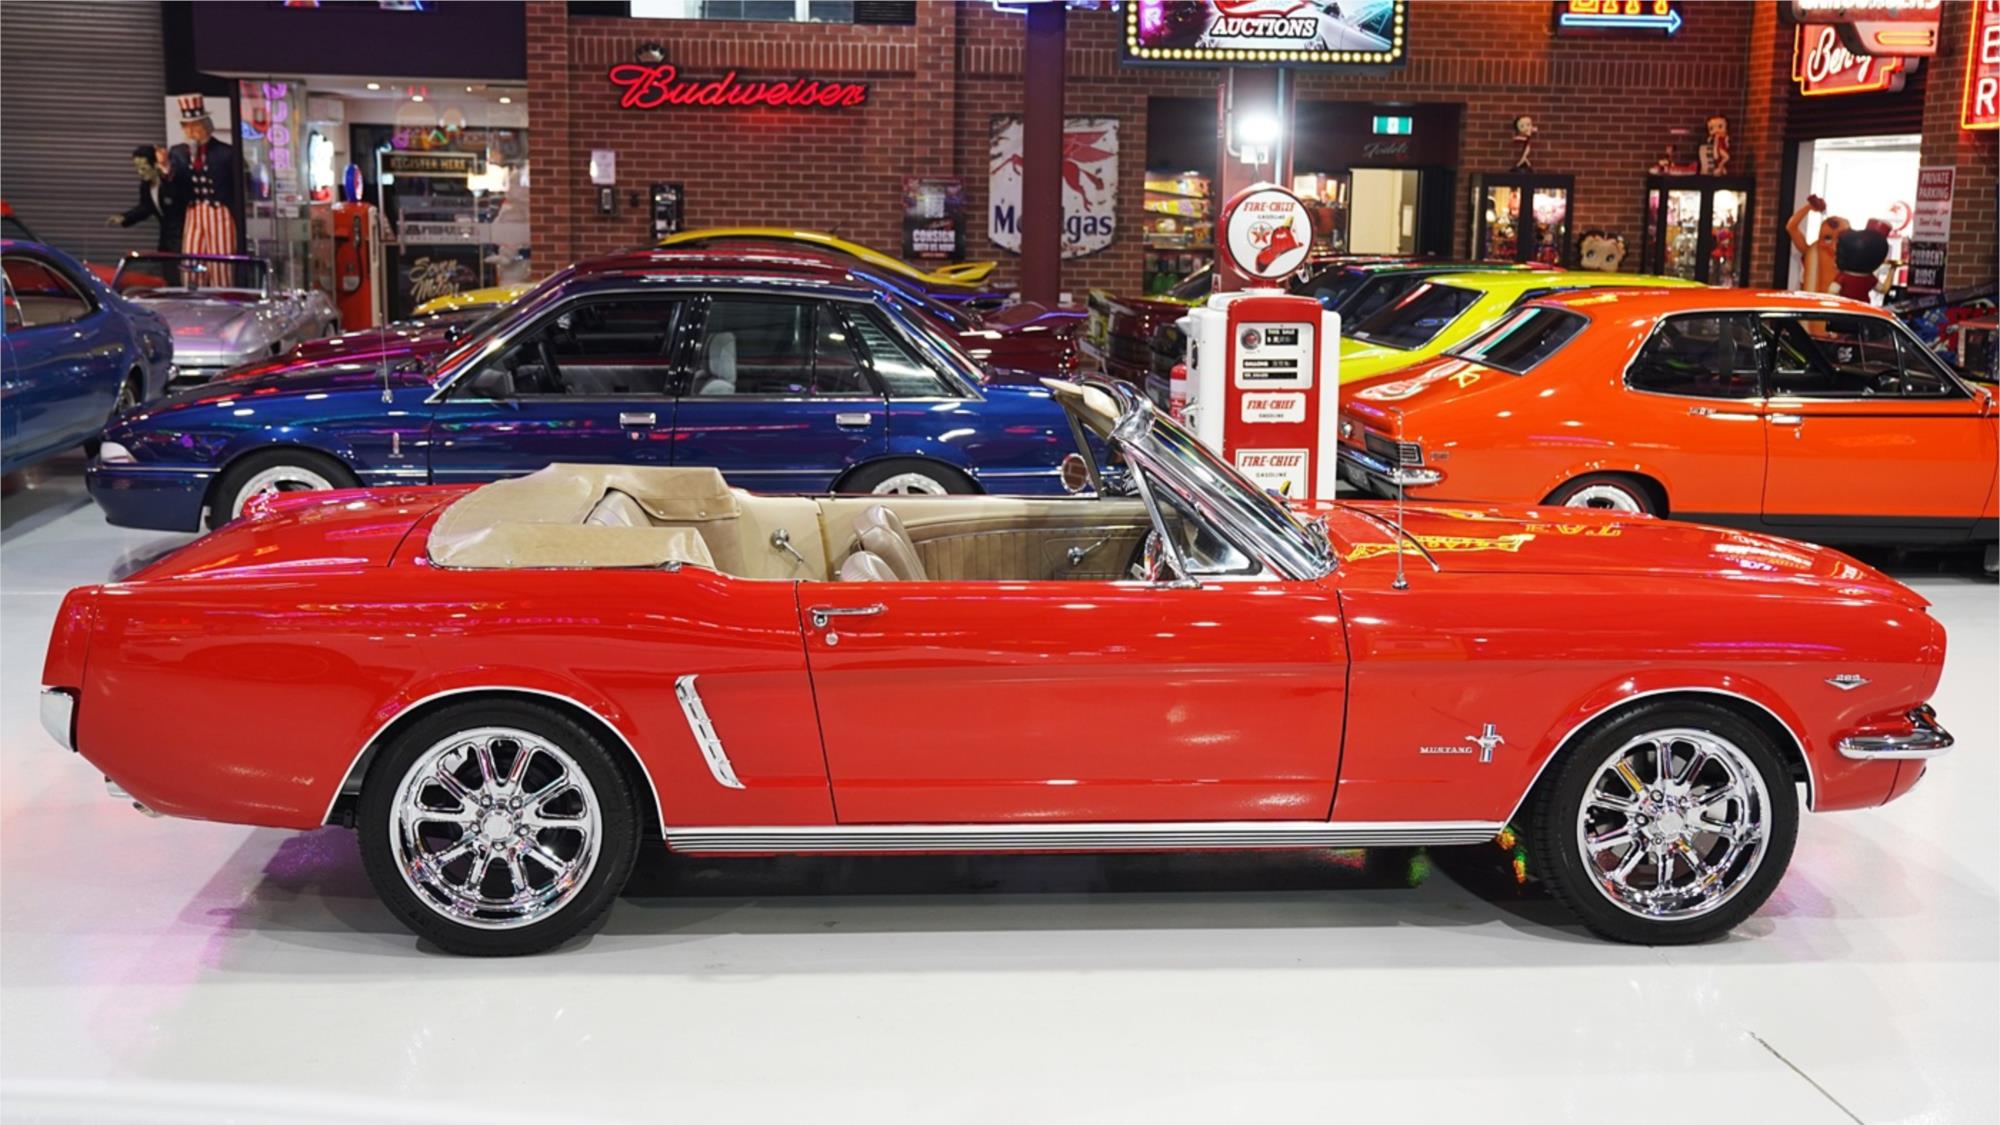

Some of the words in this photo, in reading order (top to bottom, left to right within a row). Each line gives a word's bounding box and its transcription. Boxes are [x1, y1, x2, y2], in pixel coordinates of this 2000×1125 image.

[1212, 17, 1317, 37] AUCTIONS
[609, 64, 865, 108] Budweiser
[1921, 171, 1950, 185] PRIVATE
[1919, 187, 1949, 201] PARKING
[912, 229, 955, 243] CONSIGN
[1241, 455, 1302, 467] FIRE-CHIEF
[1419, 745, 1473, 754] MUSTANG
